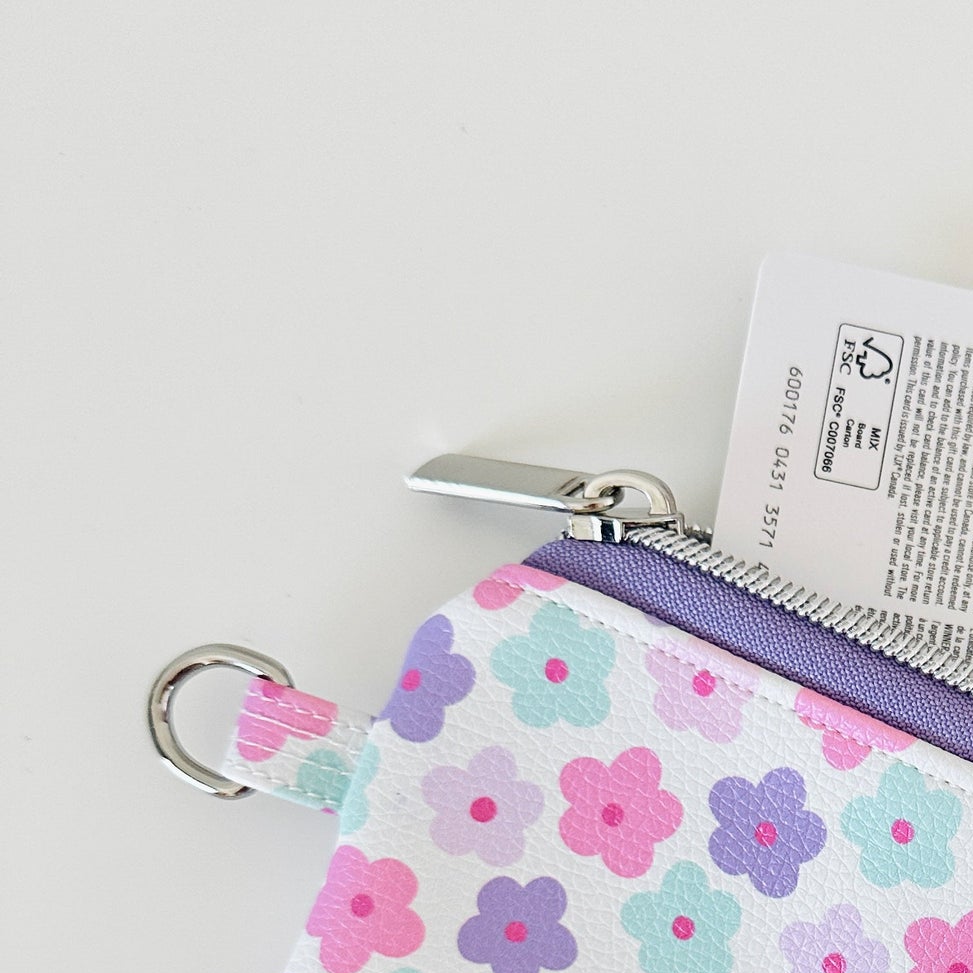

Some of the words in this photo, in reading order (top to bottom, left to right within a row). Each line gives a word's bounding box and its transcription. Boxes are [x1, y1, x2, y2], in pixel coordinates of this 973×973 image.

[840, 339, 856, 375] FSC
[779, 367, 803, 434] 600176
[821, 421, 839, 472] C007066
[843, 419, 855, 448] Carton
[854, 423, 866, 449] Board
[869, 427, 881, 450] MIX
[769, 447, 789, 490] 0431
[759, 504, 780, 548] 3571
